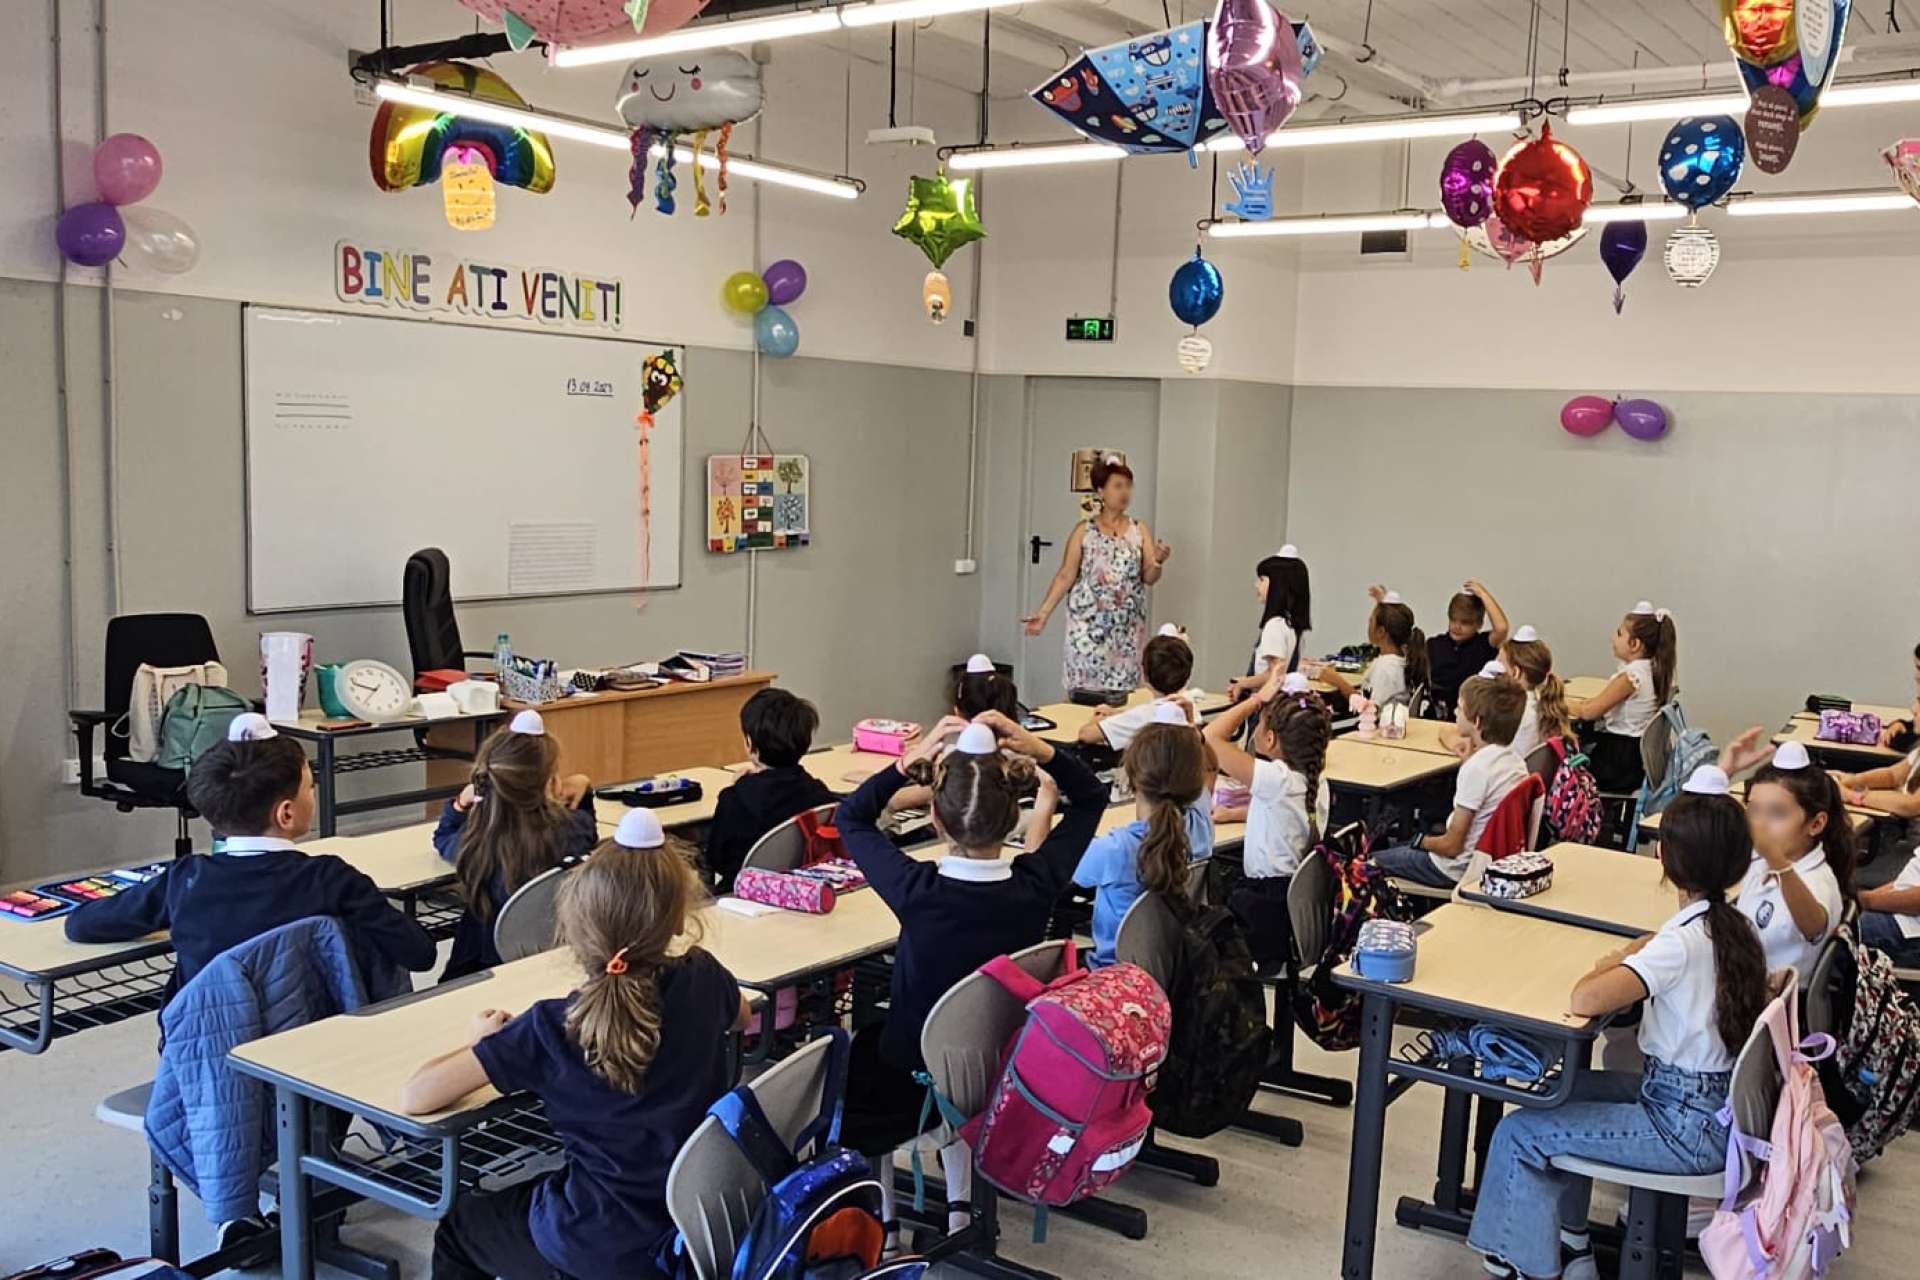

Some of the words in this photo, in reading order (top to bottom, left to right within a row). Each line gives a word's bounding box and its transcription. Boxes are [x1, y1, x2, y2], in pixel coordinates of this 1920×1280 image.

[342, 245, 431, 304] BINE
[447, 263, 508, 310] ATI
[521, 270, 621, 325] VENIT!
